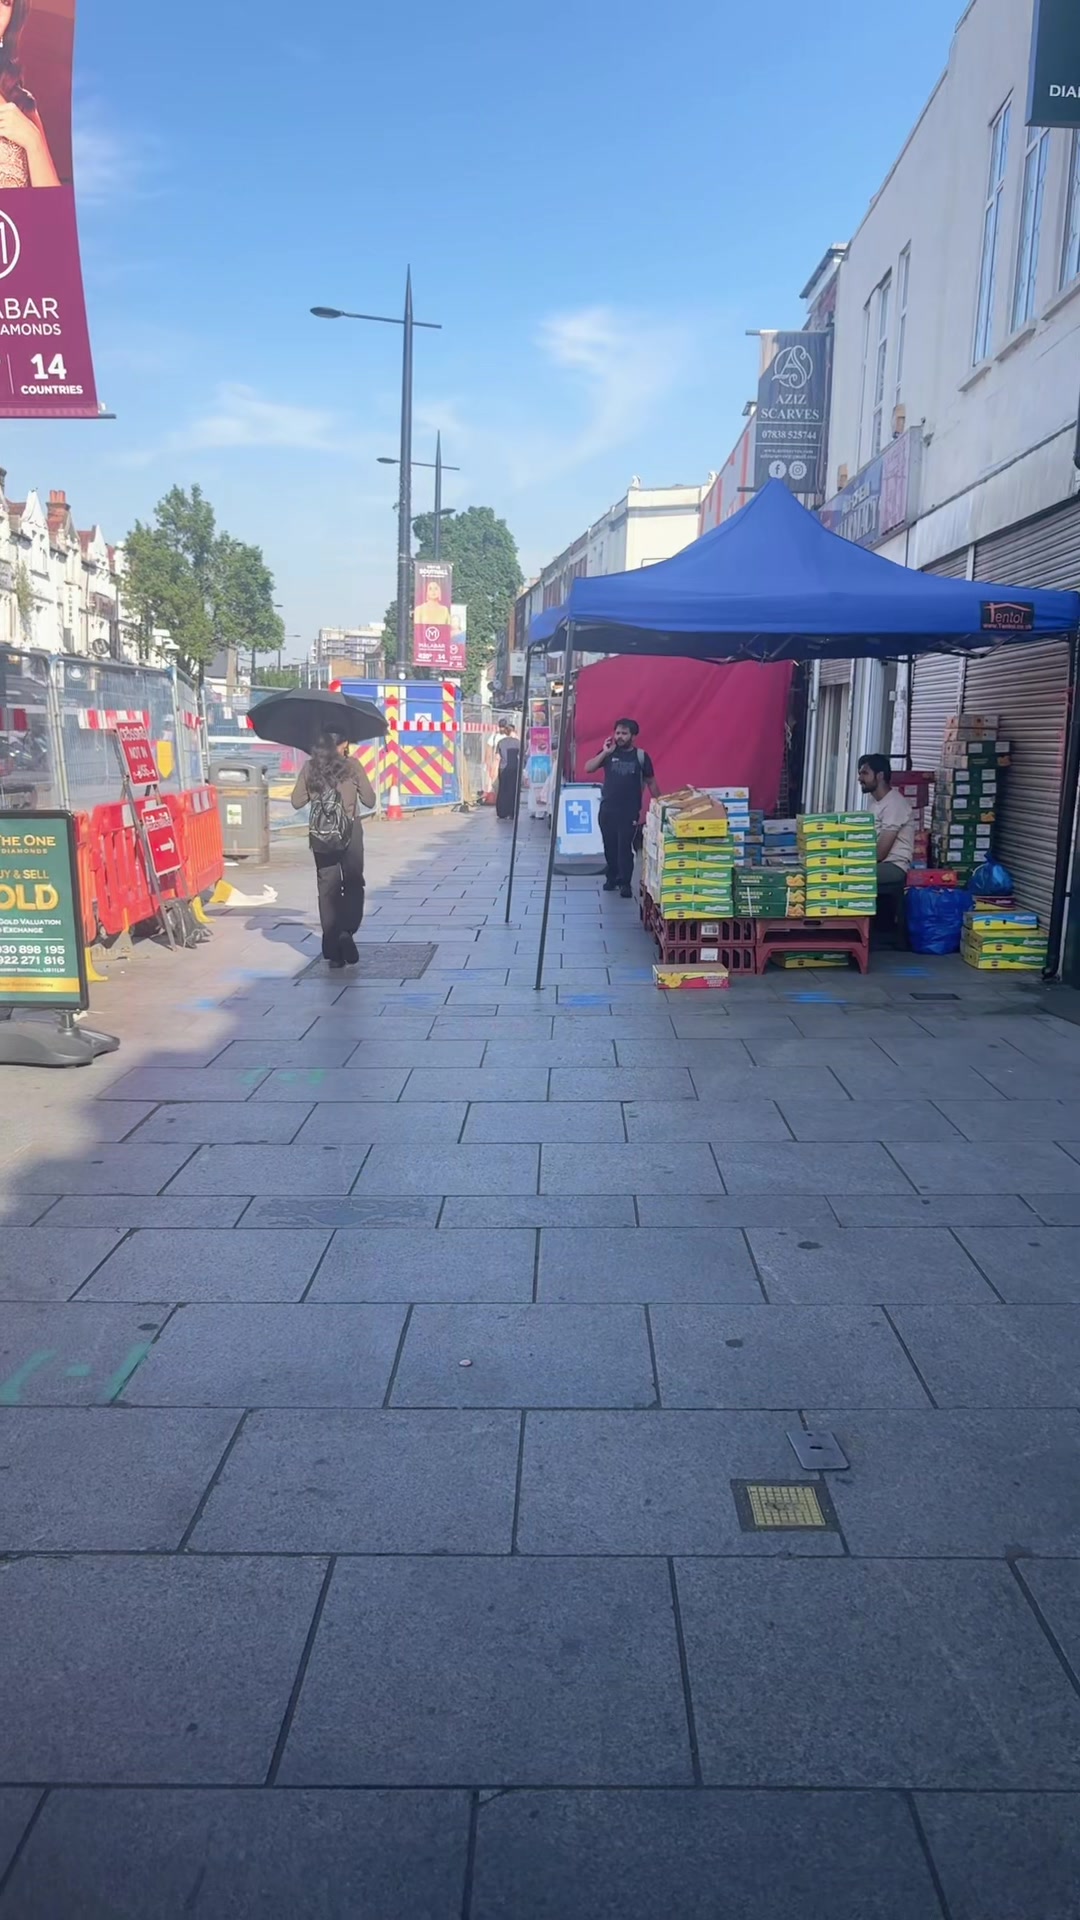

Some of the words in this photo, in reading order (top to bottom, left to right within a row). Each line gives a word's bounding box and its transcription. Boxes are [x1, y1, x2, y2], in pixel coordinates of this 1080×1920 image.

[1049, 84, 1080, 98] DIA
[0, 298, 60, 319] BAR
[30, 353, 67, 380] 14
[21, 384, 83, 395] COUNTRIES
[775, 394, 807, 405] AZIZ
[760, 408, 820, 420] SCARVES
[0, 834, 21, 846] HE
[24, 834, 56, 846] ONE
[23, 870, 49, 879] SELL
[3, 926, 44, 934] EXCHANGE
[0, 945, 17, 954] 30
[19, 945, 41, 954] 898
[44, 945, 65, 954] 195
[20, 956, 40, 965] 271
[43, 956, 65, 965] 816
